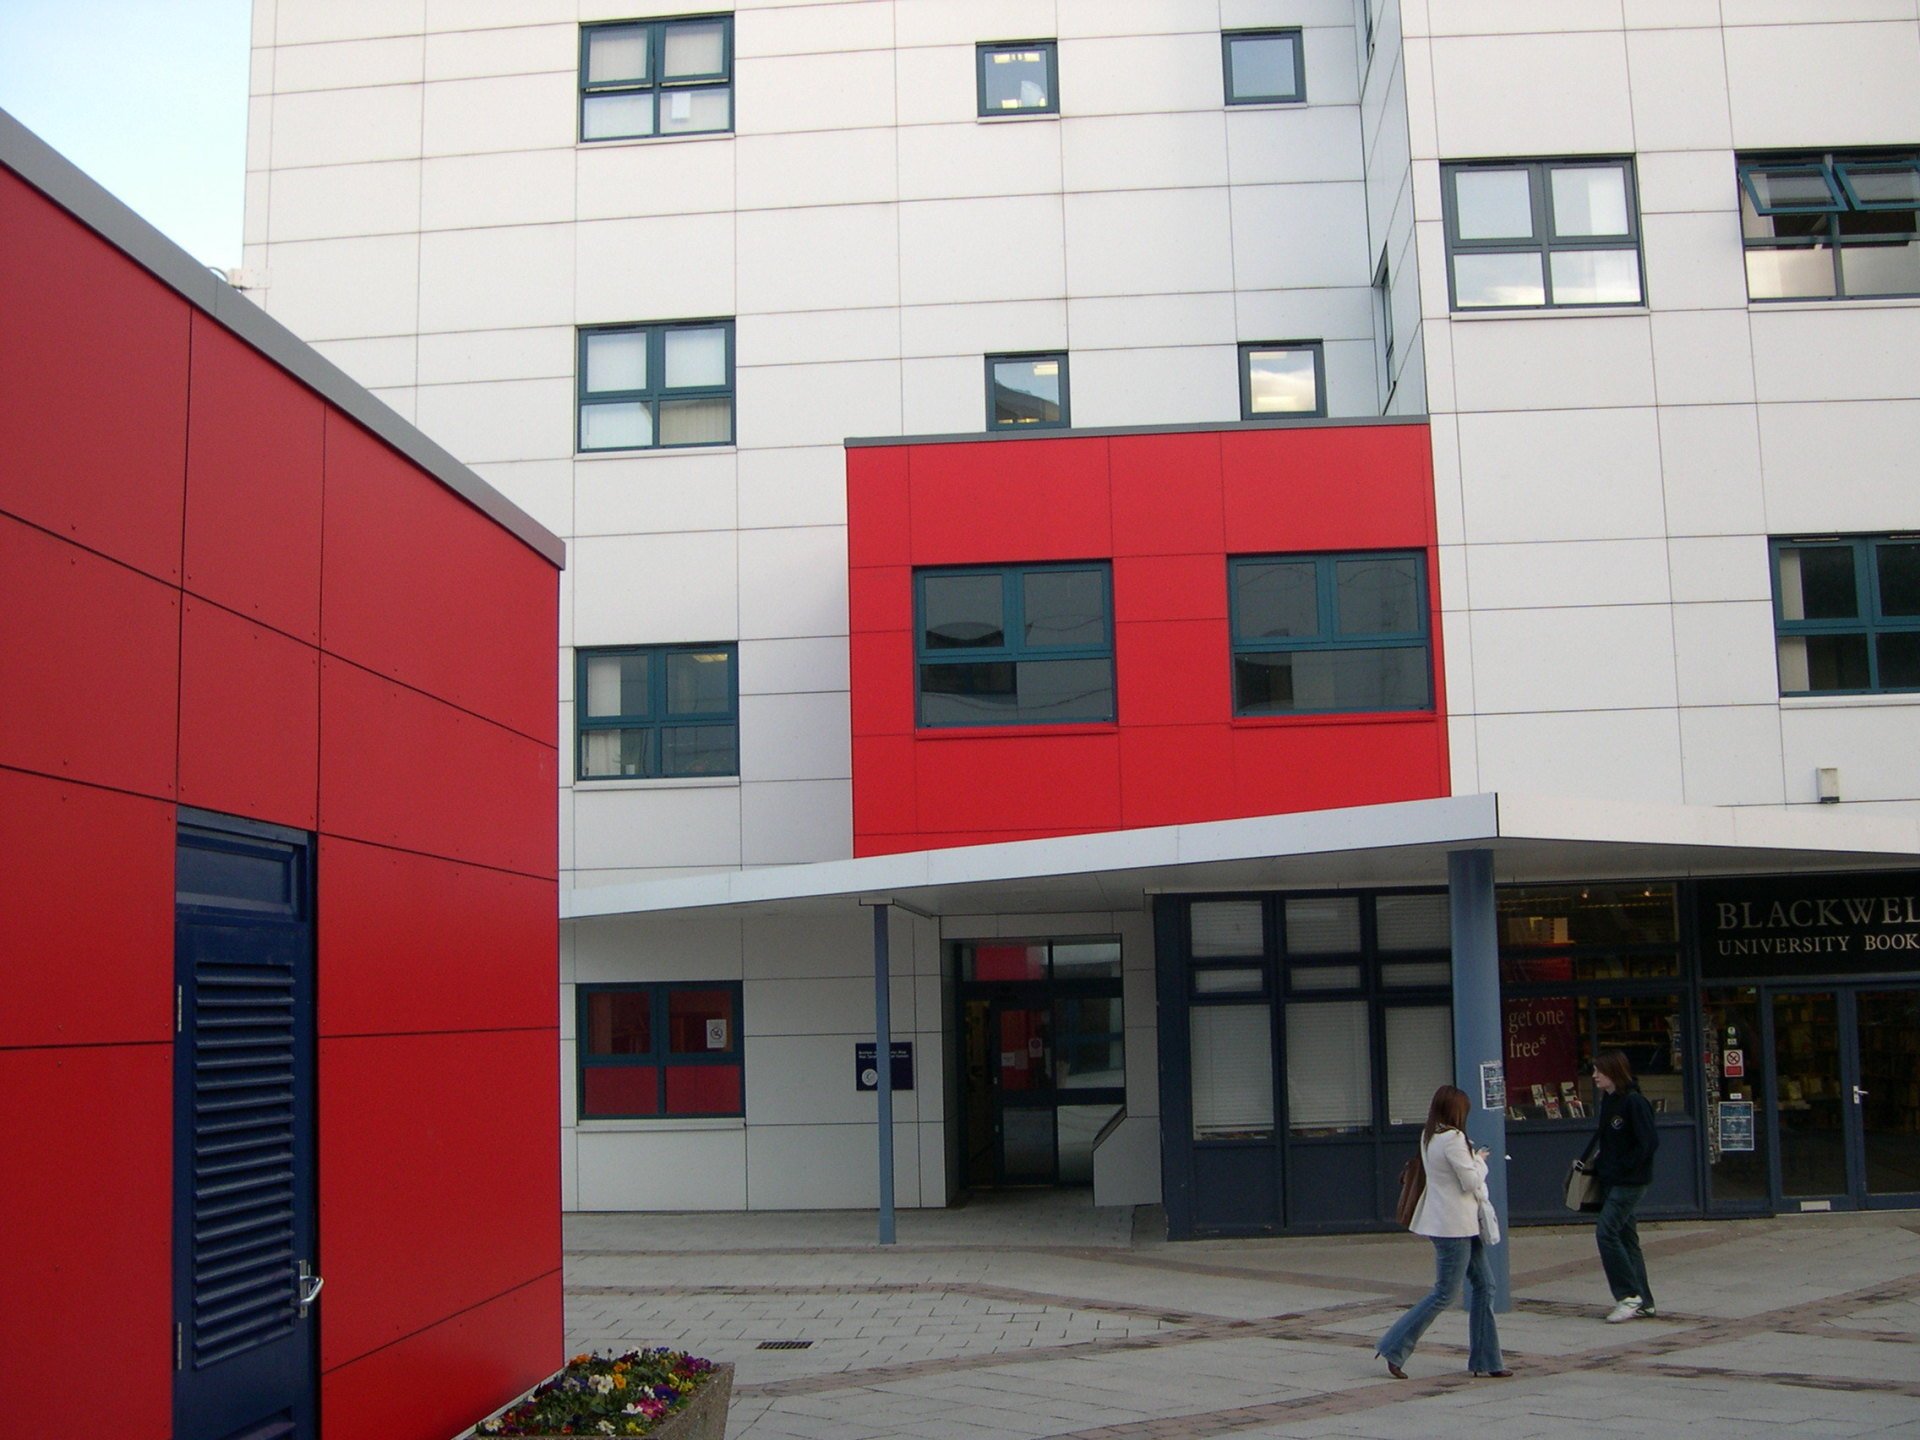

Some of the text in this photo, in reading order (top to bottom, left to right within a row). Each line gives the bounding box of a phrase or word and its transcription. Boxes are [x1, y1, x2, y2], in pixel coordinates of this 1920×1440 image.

[1717, 935, 1850, 956] UNIVERSITY
[1508, 1008, 1565, 1034] get one
